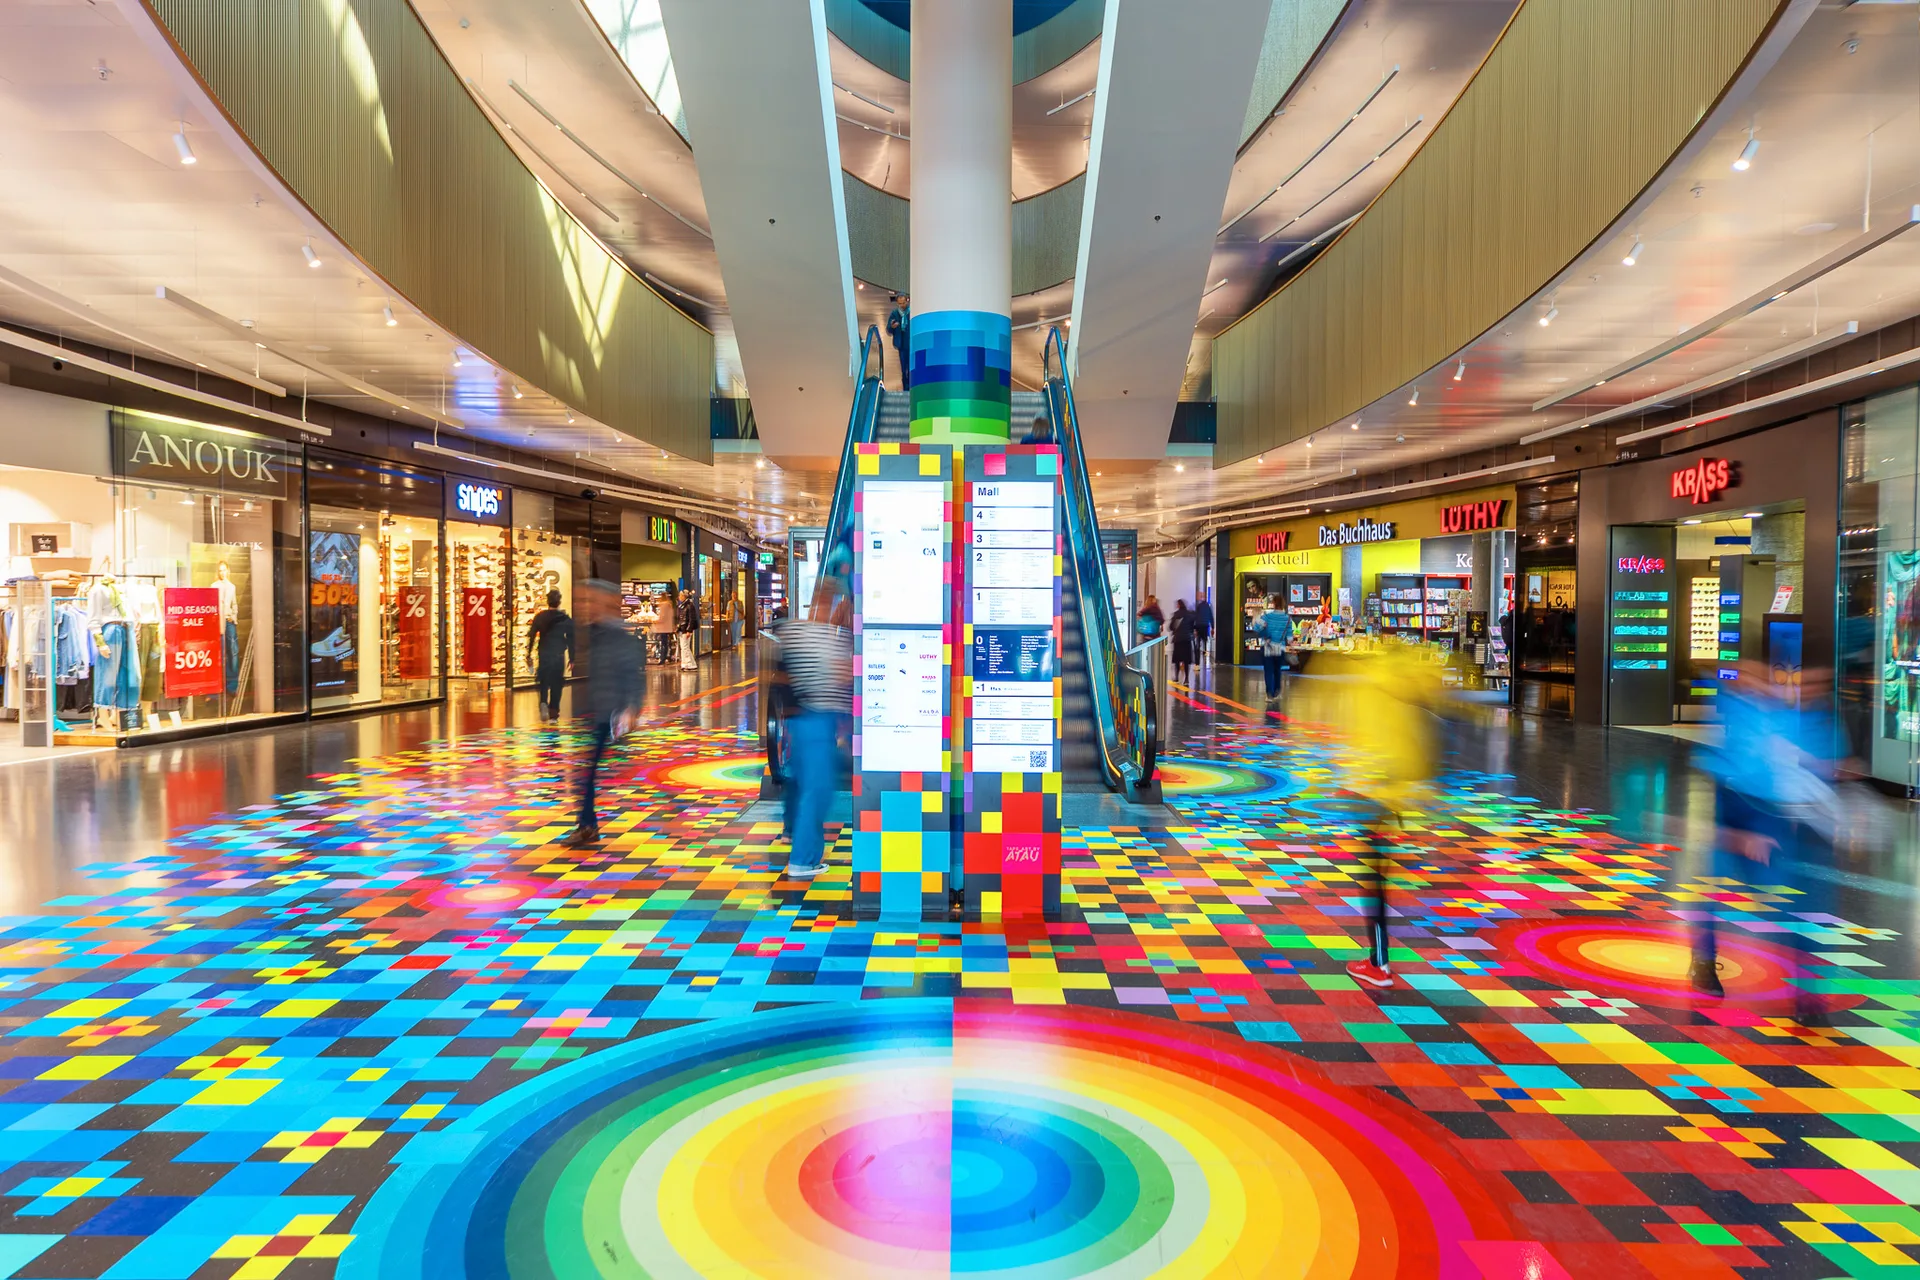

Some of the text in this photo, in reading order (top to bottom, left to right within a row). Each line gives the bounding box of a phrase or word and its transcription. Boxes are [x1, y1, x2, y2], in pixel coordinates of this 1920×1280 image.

[129, 431, 279, 483] ANOUK
[1672, 457, 1729, 505] KRASS
[978, 487, 999, 496] Mall
[458, 483, 498, 517] snipes
[976, 511, 983, 519] 4
[1440, 500, 1502, 533] LÜTHY
[1319, 518, 1391, 546] Das Buchhaus
[976, 534, 983, 543] 3
[976, 552, 983, 561] 2
[1256, 552, 1309, 565] Aktuell
[311, 584, 358, 606] 50%
[976, 592, 981, 601] 1
[167, 605, 218, 615] MID SEASON
[182, 618, 204, 627] SALE
[976, 635, 983, 645] 0
[175, 650, 212, 670] 50%
